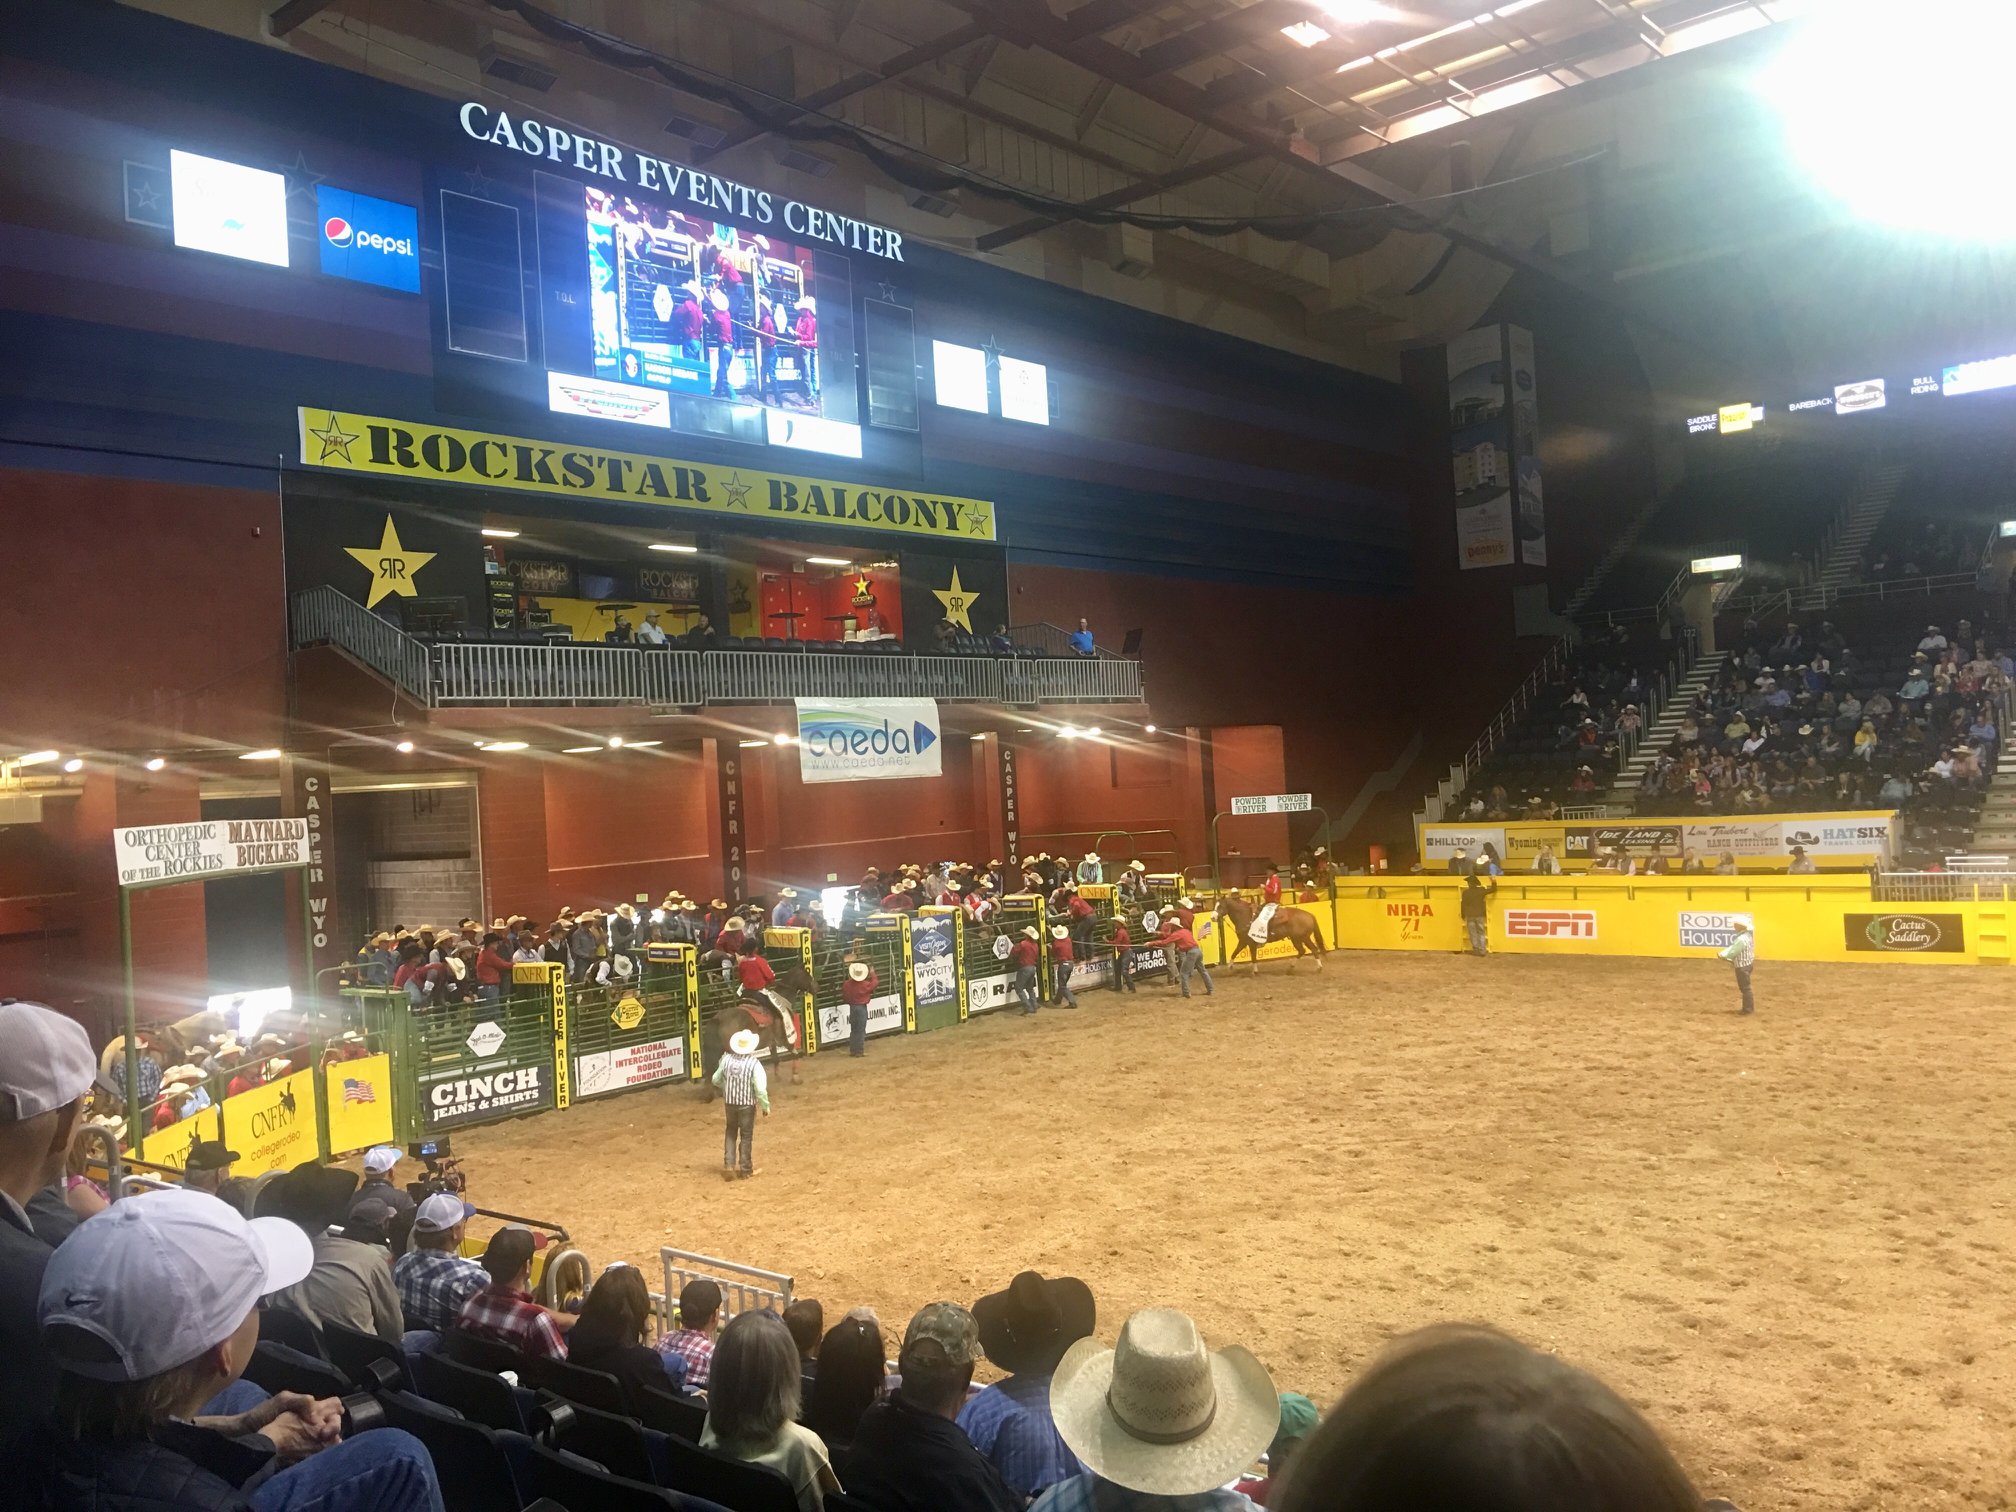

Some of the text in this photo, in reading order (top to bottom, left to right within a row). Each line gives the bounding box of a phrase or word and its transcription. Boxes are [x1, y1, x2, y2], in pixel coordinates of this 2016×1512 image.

[460, 102, 905, 262] CASPER EVENTS CENTER
[357, 231, 413, 256] pepsi
[1913, 376, 1935, 386] BULL
[1911, 383, 1939, 395] RIDING
[1789, 398, 1833, 411] BAREBACK
[1687, 414, 1718, 426] SADDLE
[1690, 422, 1716, 433] BRONC
[366, 424, 964, 530] ROCKSTAR BALCONY
[808, 719, 910, 757] caeda
[811, 756, 911, 770] www.caeda.net
[1004, 750, 1017, 864] CASPER WYO
[1235, 794, 1308, 805] POWDER POWDER
[1242, 802, 1308, 813] RIVER RIVER
[124, 824, 217, 847] ORTHOPEDIC
[228, 820, 304, 843] MAYNARD
[726, 761, 740, 900] CNFR 201
[1625, 830, 1661, 839] LAND
[1687, 825, 1749, 836] Lou Taubert
[1434, 838, 1476, 846] HILLTOP
[1508, 837, 1541, 850] Wyoming
[1566, 836, 1589, 850] CAT
[1707, 837, 1779, 848] RANCH OUTFITTERS
[145, 841, 202, 861] CENTER
[236, 841, 299, 866] BUCKLES
[122, 854, 223, 882] OF THE ROCKIES
[305, 777, 328, 947] CASPER WYO
[1080, 888, 1106, 898] CNFR
[1387, 904, 1433, 917] NIRA
[1400, 918, 1419, 932] 71
[1508, 912, 1593, 936] ESPN
[1681, 914, 1733, 928] RODE
[1893, 919, 1926, 931] Cactus
[767, 934, 794, 946] CNFR
[1681, 930, 1738, 946] HOUSTO
[1886, 931, 1930, 945] Saddlery
[1136, 949, 1164, 962] WE AR
[515, 967, 544, 981] CNFR
[904, 928, 914, 1022] CNFR
[993, 981, 1015, 996] RA
[688, 959, 700, 1069] CNFR
[867, 1005, 900, 1019] LUMNI, INC.
[806, 1003, 815, 1049] RIVER
[555, 973, 567, 1105] POWDER RIVER
[631, 1042, 667, 1056] NATIONAL
[615, 1047, 682, 1068] INTERCOLLEGIATE
[637, 1061, 662, 1072] RODEO
[626, 1067, 673, 1084] FOUNDATION
[431, 1067, 539, 1106] CINCH
[433, 1101, 476, 1121] JEANS
[479, 1100, 490, 1110] &
[492, 1089, 539, 1107] SHIRTS
[251, 1104, 287, 1139] CNFR
[250, 1130, 301, 1162] collegerodeo
[163, 1145, 193, 1169] CNF
[270, 1152, 287, 1169] com
